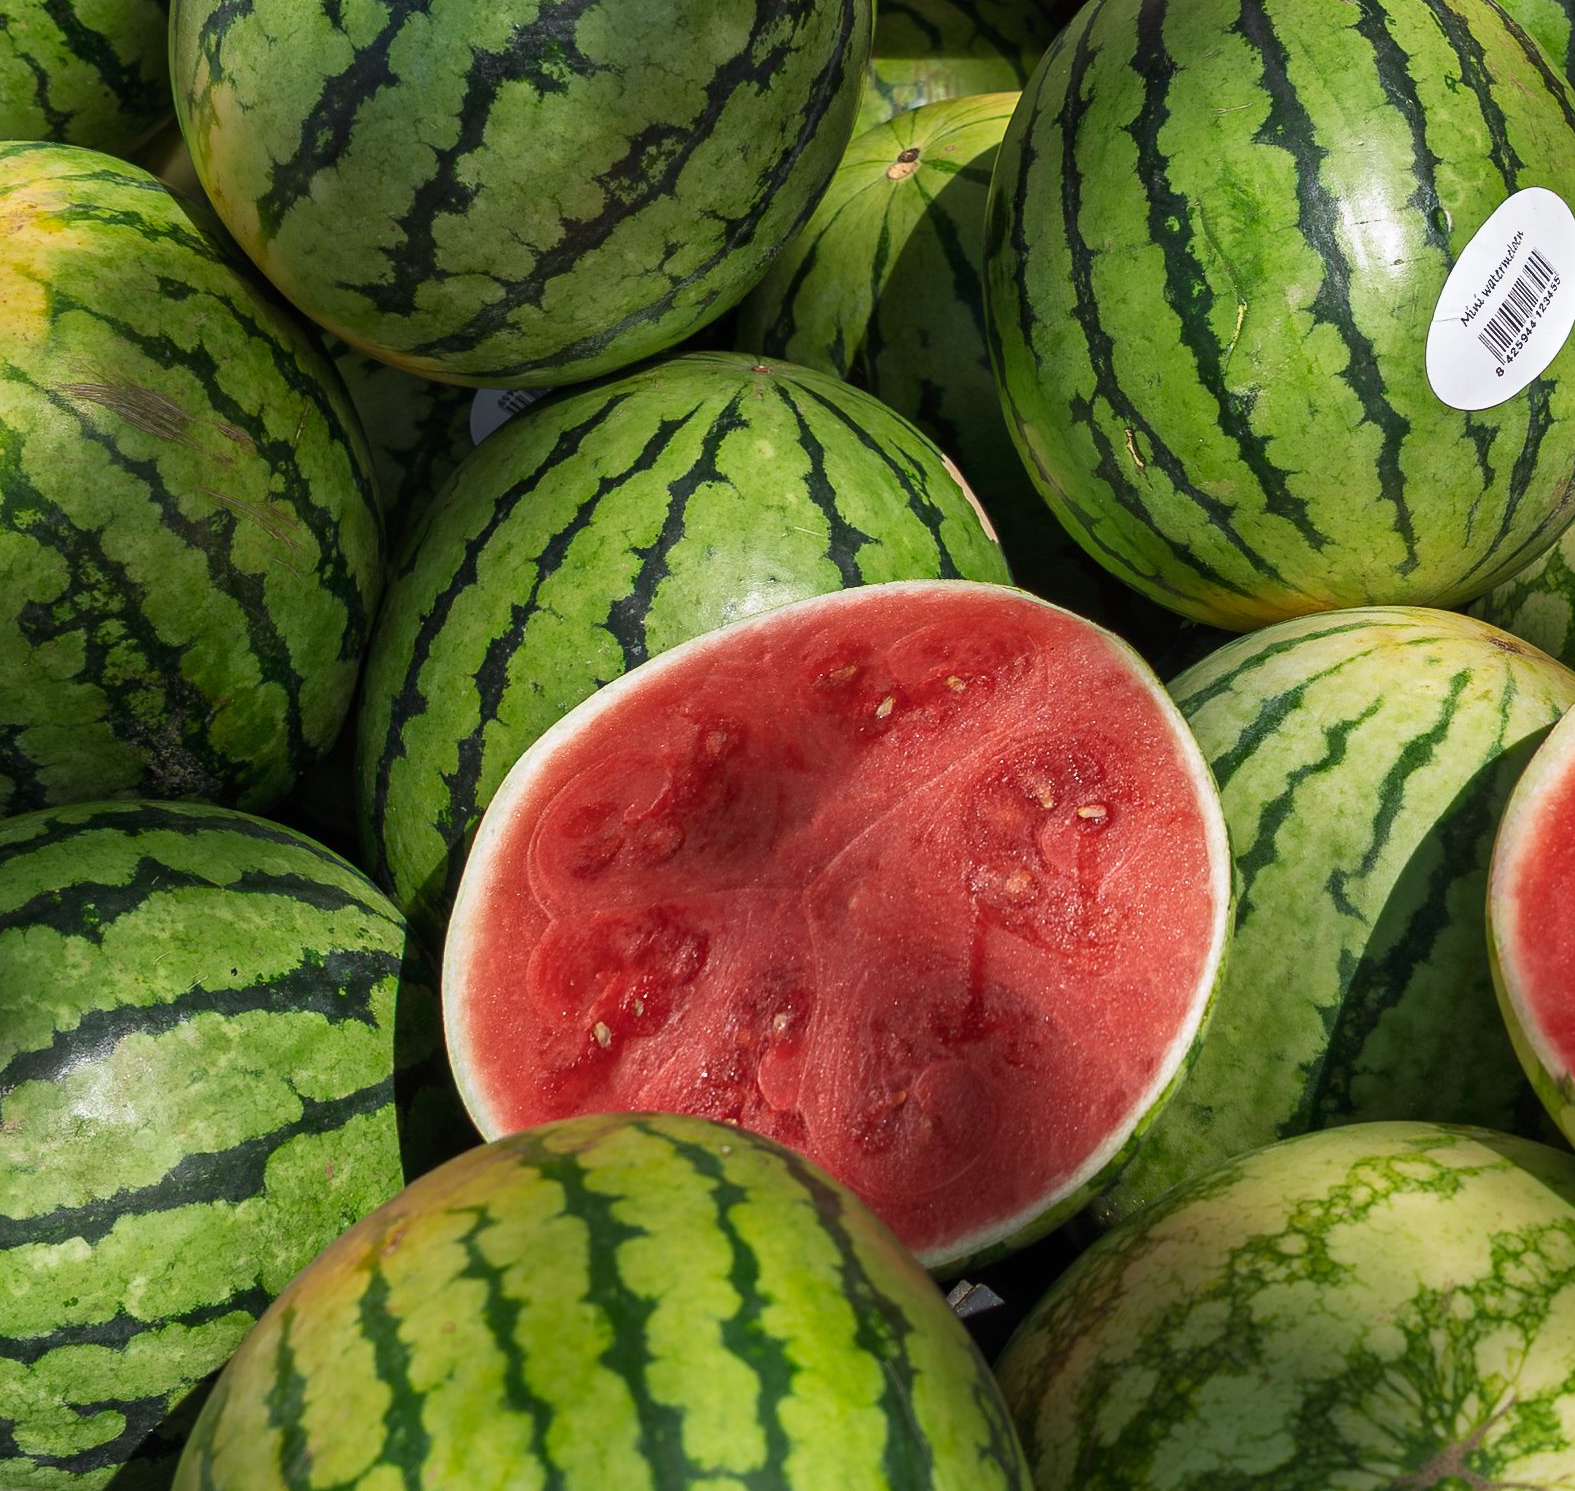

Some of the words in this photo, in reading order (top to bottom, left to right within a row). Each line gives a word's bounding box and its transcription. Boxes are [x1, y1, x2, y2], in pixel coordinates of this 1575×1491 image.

[1461, 294, 1484, 327] Mini
[1482, 231, 1524, 297] watermeloen
[1496, 367, 1505, 377] 8
